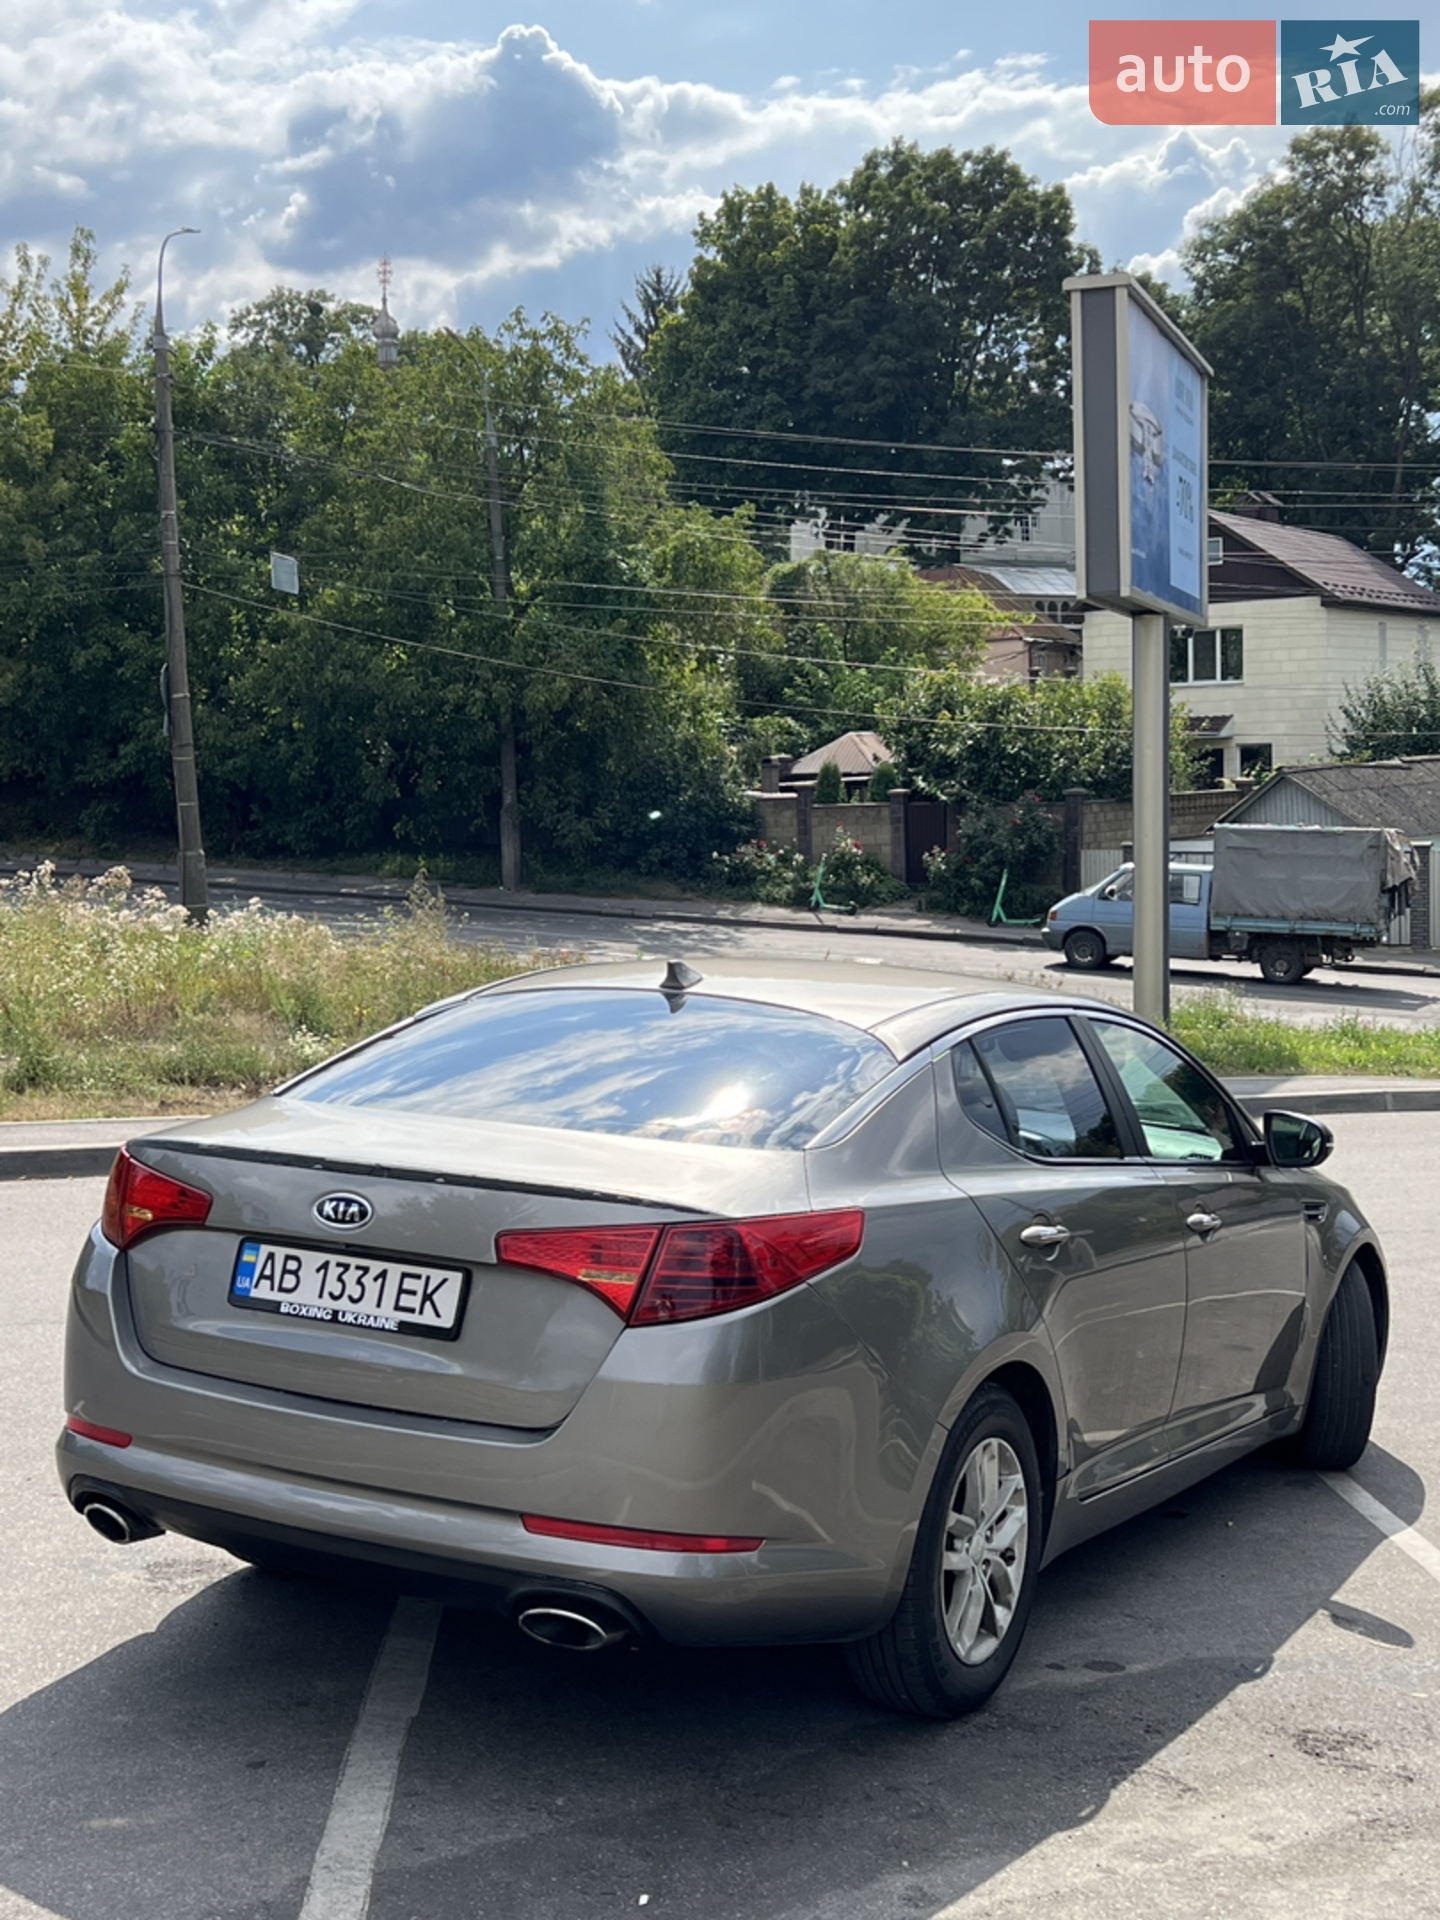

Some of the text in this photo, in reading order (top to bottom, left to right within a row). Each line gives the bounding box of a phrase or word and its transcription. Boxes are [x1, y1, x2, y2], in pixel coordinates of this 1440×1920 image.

[322, 1200, 361, 1222] KIA
[236, 1276, 250, 1289] UA
[254, 1251, 302, 1294] AB
[315, 1260, 388, 1308] 1331
[280, 1302, 399, 1331] BOXING UKRAINE
